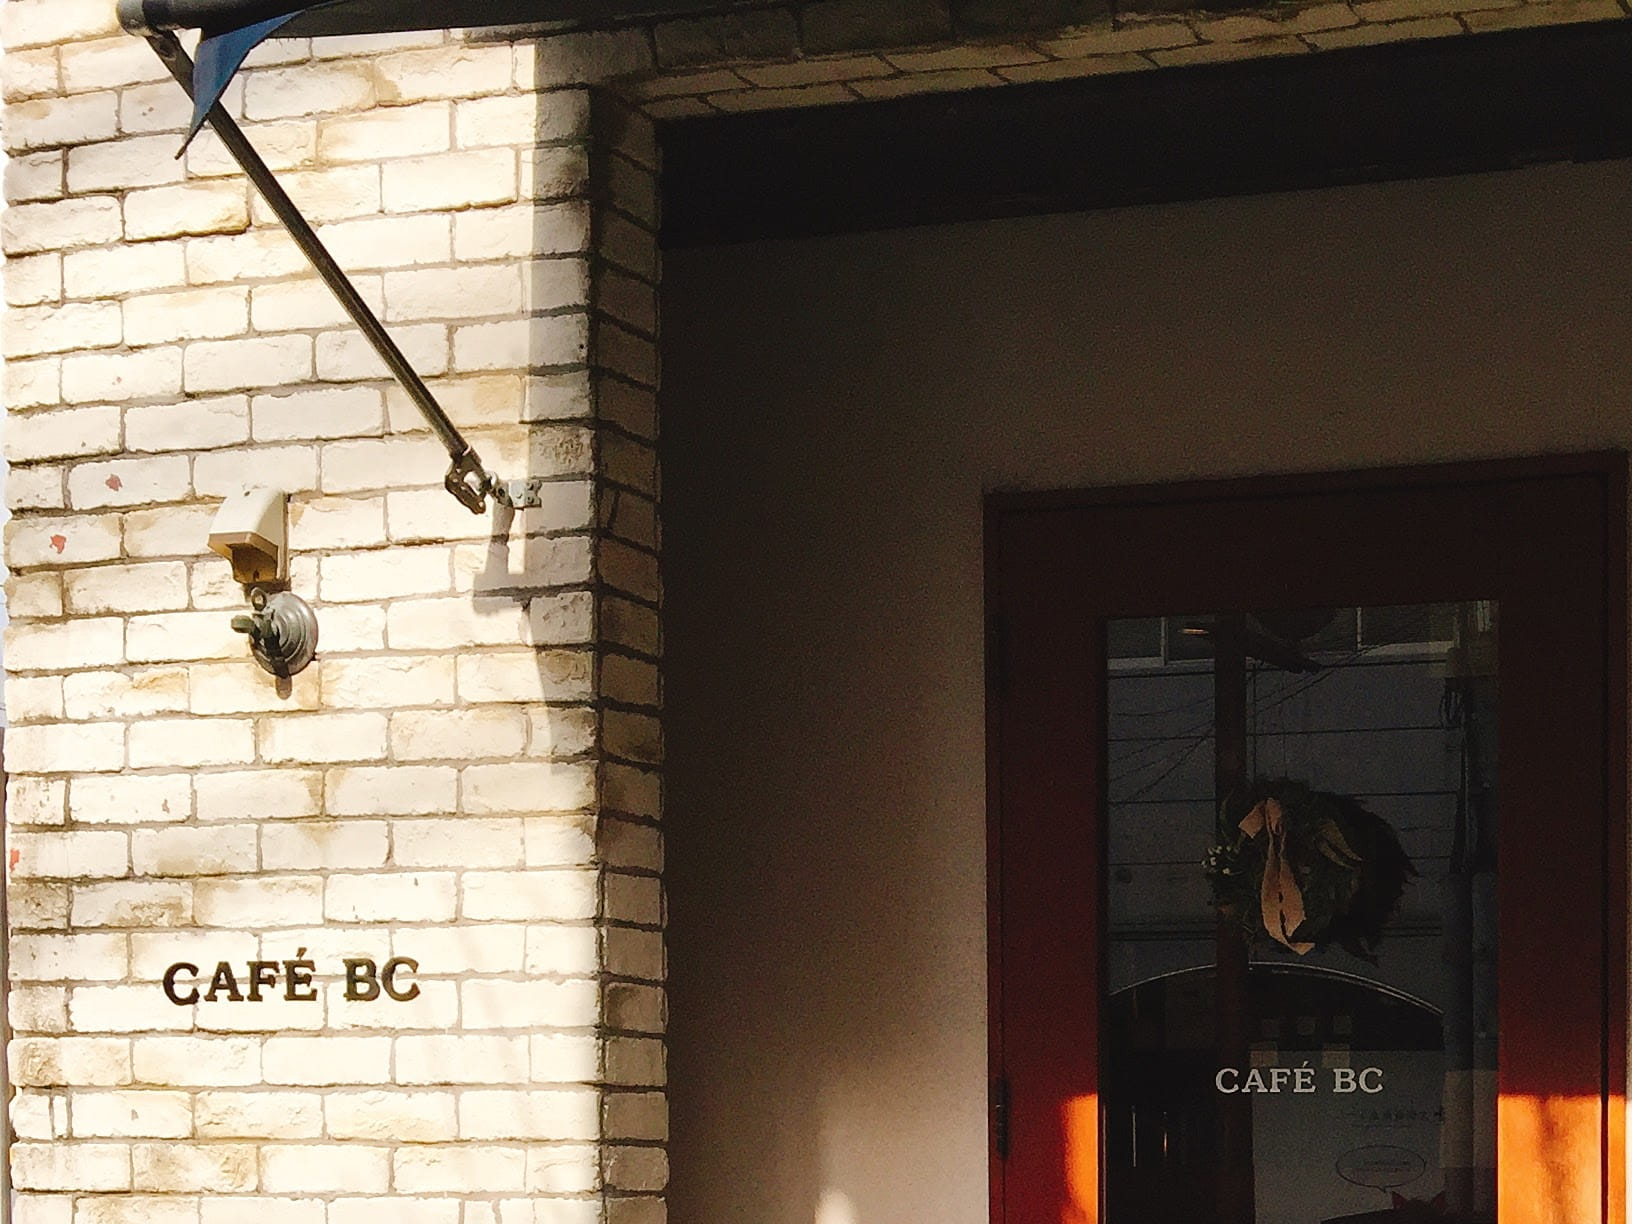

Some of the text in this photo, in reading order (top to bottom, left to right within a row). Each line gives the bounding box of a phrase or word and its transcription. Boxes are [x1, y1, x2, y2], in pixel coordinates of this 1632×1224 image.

[163, 947, 421, 1006] CAFÉ BC
[1215, 1061, 1384, 1094] CAFÉ BC
